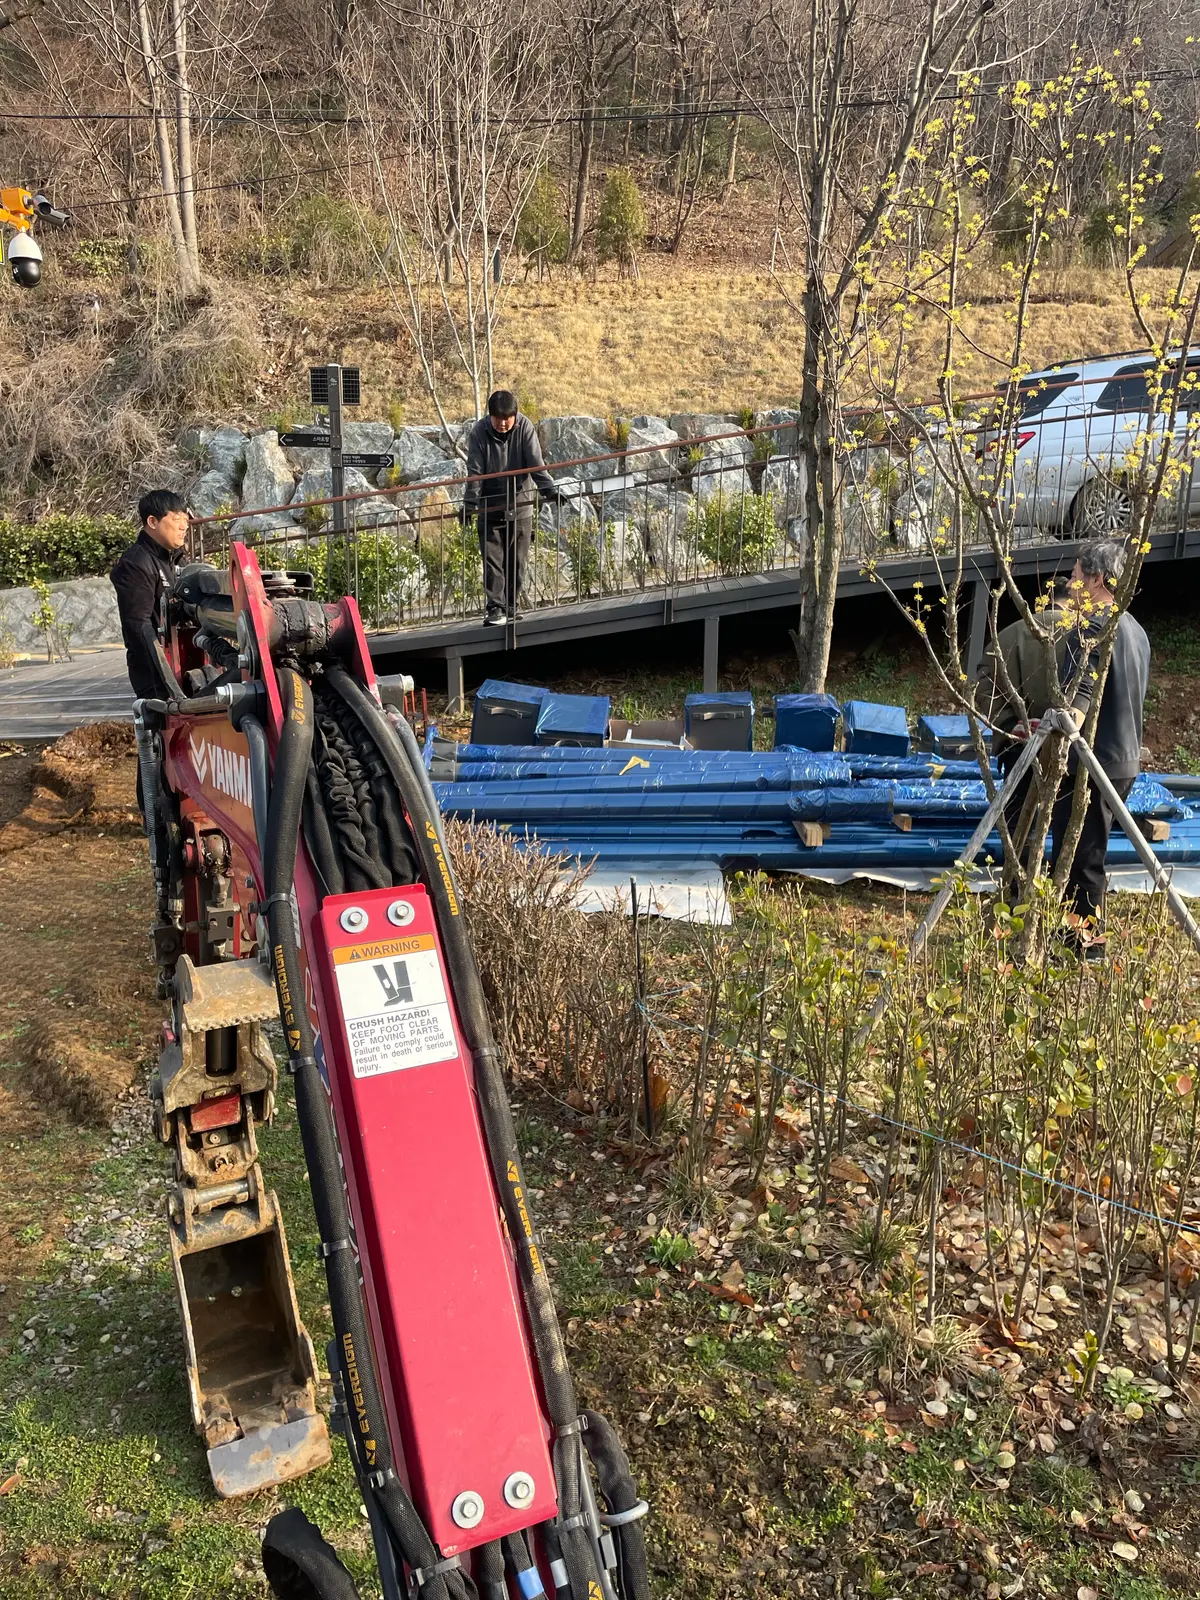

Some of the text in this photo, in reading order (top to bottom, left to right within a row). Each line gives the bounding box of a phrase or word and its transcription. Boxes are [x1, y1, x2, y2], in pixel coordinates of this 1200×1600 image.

[433, 843, 459, 916] EVERDIGM
[361, 939, 420, 957] WARNING
[274, 944, 295, 1026] EVERDIGM
[349, 1009, 430, 1031] CRUSH HAZARD!
[351, 1017, 439, 1040] KEEP FOOT CLEAR
[352, 1025, 442, 1048] OF MOVING PARTS.
[354, 1045, 381, 1057] Failure
[394, 1038, 421, 1050] comply
[424, 1032, 445, 1043] could
[355, 1054, 378, 1065] result
[381, 1050, 388, 1059] in
[391, 1047, 412, 1058] death
[426, 1039, 453, 1051] serious
[357, 1062, 382, 1074] injury.
[343, 1332, 370, 1434] EVERDIGM
